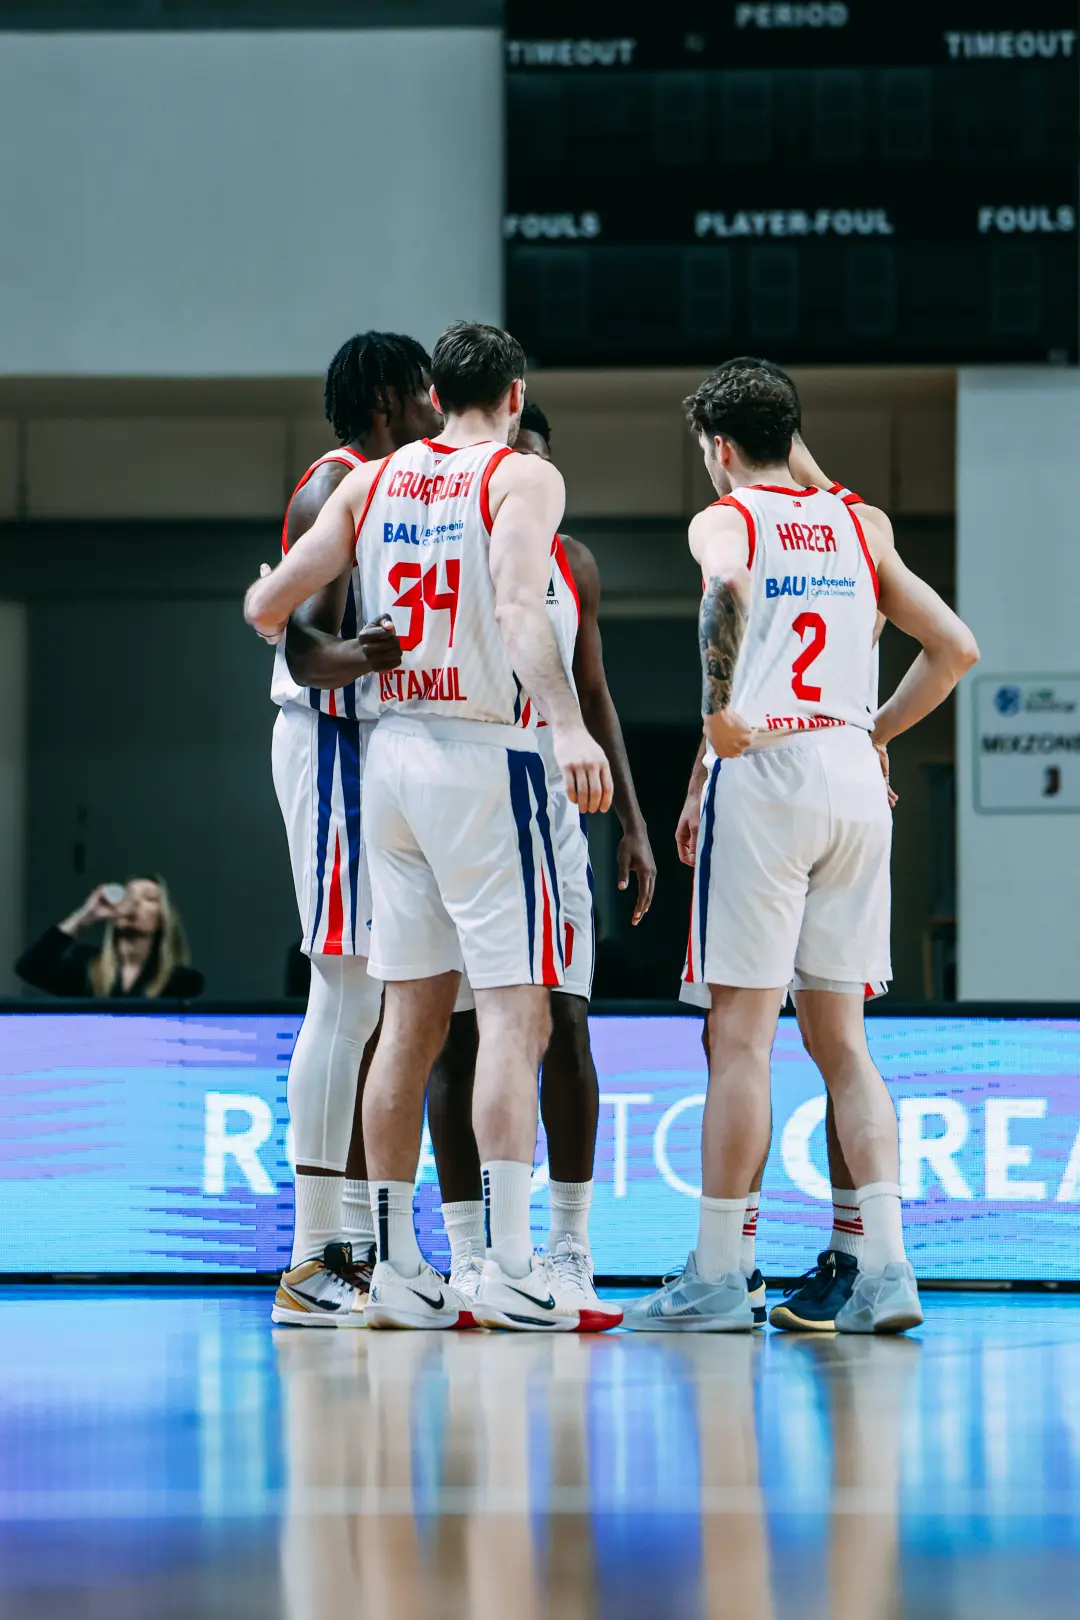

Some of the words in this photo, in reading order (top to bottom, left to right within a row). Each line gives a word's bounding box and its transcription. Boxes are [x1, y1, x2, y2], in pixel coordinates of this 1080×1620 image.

[734, 2, 849, 28] PERIOD
[507, 38, 635, 66] TIMEOUT
[943, 30, 1077, 59] TIMEOUT
[503, 212, 600, 239] FOULS
[978, 204, 1075, 234] FOULS
[383, 522, 420, 545] BAU
[776, 523, 837, 553] HAZER
[766, 576, 806, 599] BAU
[388, 559, 460, 651] 34
[791, 612, 826, 702] 2
